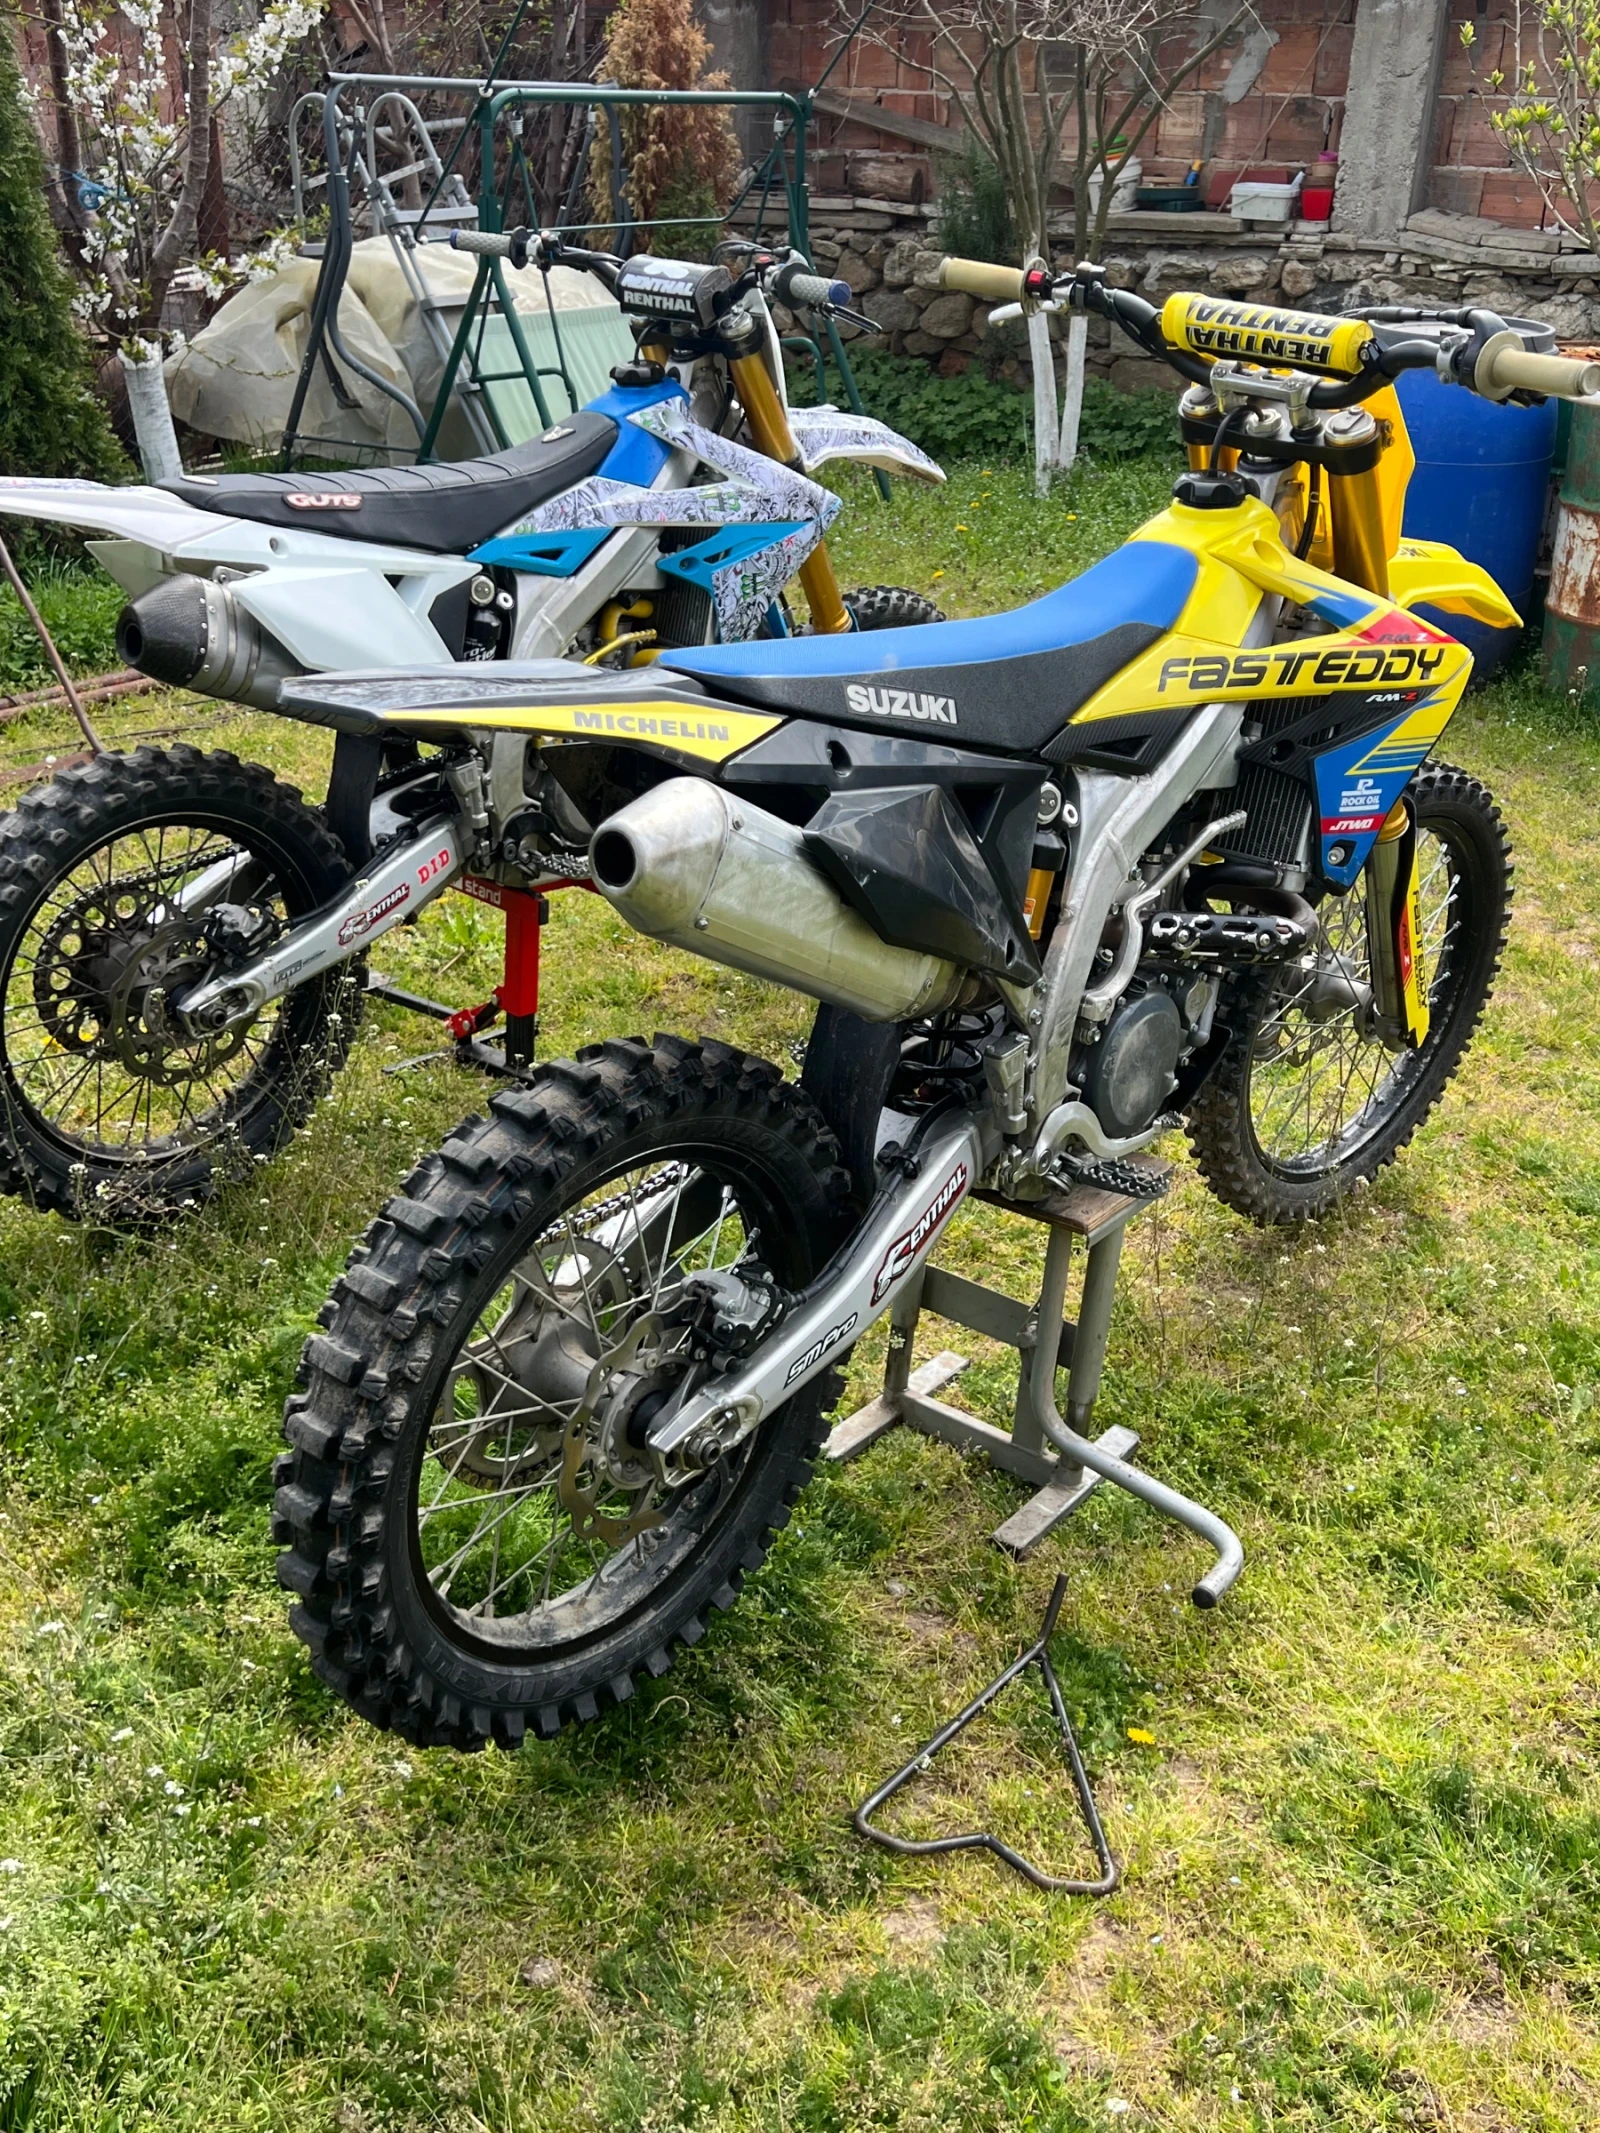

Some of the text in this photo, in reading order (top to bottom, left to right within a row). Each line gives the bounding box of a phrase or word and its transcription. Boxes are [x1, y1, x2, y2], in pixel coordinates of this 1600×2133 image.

[621, 274, 694, 297] RENTHAL
[624, 291, 695, 313] RENTHAL
[287, 493, 362, 507] GUTS
[846, 684, 958, 724] SUZUKI
[1365, 692, 1418, 703] RM-Z
[573, 711, 729, 741] MICHELIN
[1341, 794, 1380, 807] ROCK OIL
[417, 849, 450, 885] DID
[465, 880, 501, 905] stand
